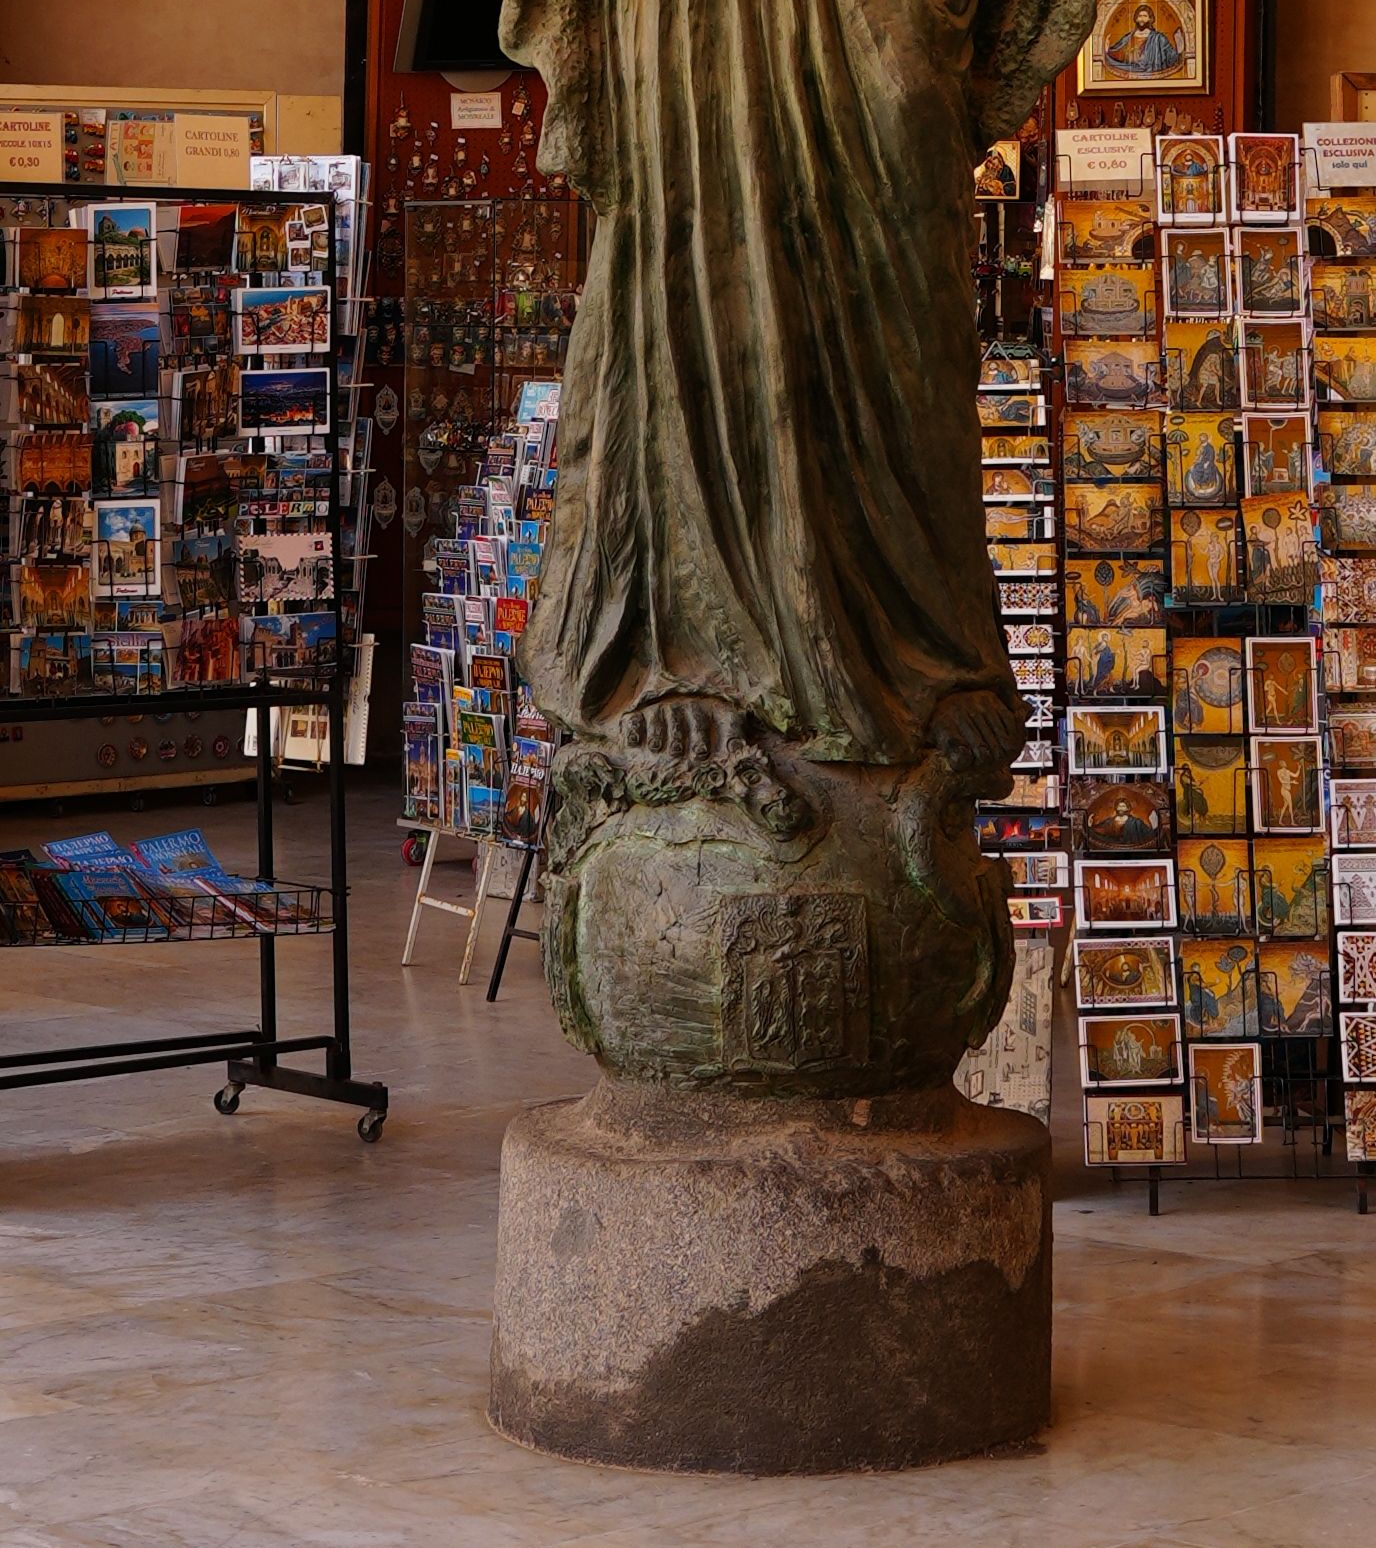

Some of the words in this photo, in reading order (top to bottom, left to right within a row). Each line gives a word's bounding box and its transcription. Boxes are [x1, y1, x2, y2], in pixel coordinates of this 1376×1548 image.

[184, 129, 239, 143] CARTOLINE
[1071, 133, 1139, 143] CARTOLINE
[184, 146, 222, 158] GRANDI
[1076, 145, 1136, 155] ESCLUSIVE
[1323, 148, 1376, 158] ESCLUSIVA
[1087, 160, 1096, 170] €
[1332, 160, 1350, 169] solo
[1352, 160, 1368, 170] qui
[107, 634, 147, 648] Sicilia
[140, 830, 201, 855] PALERMO
